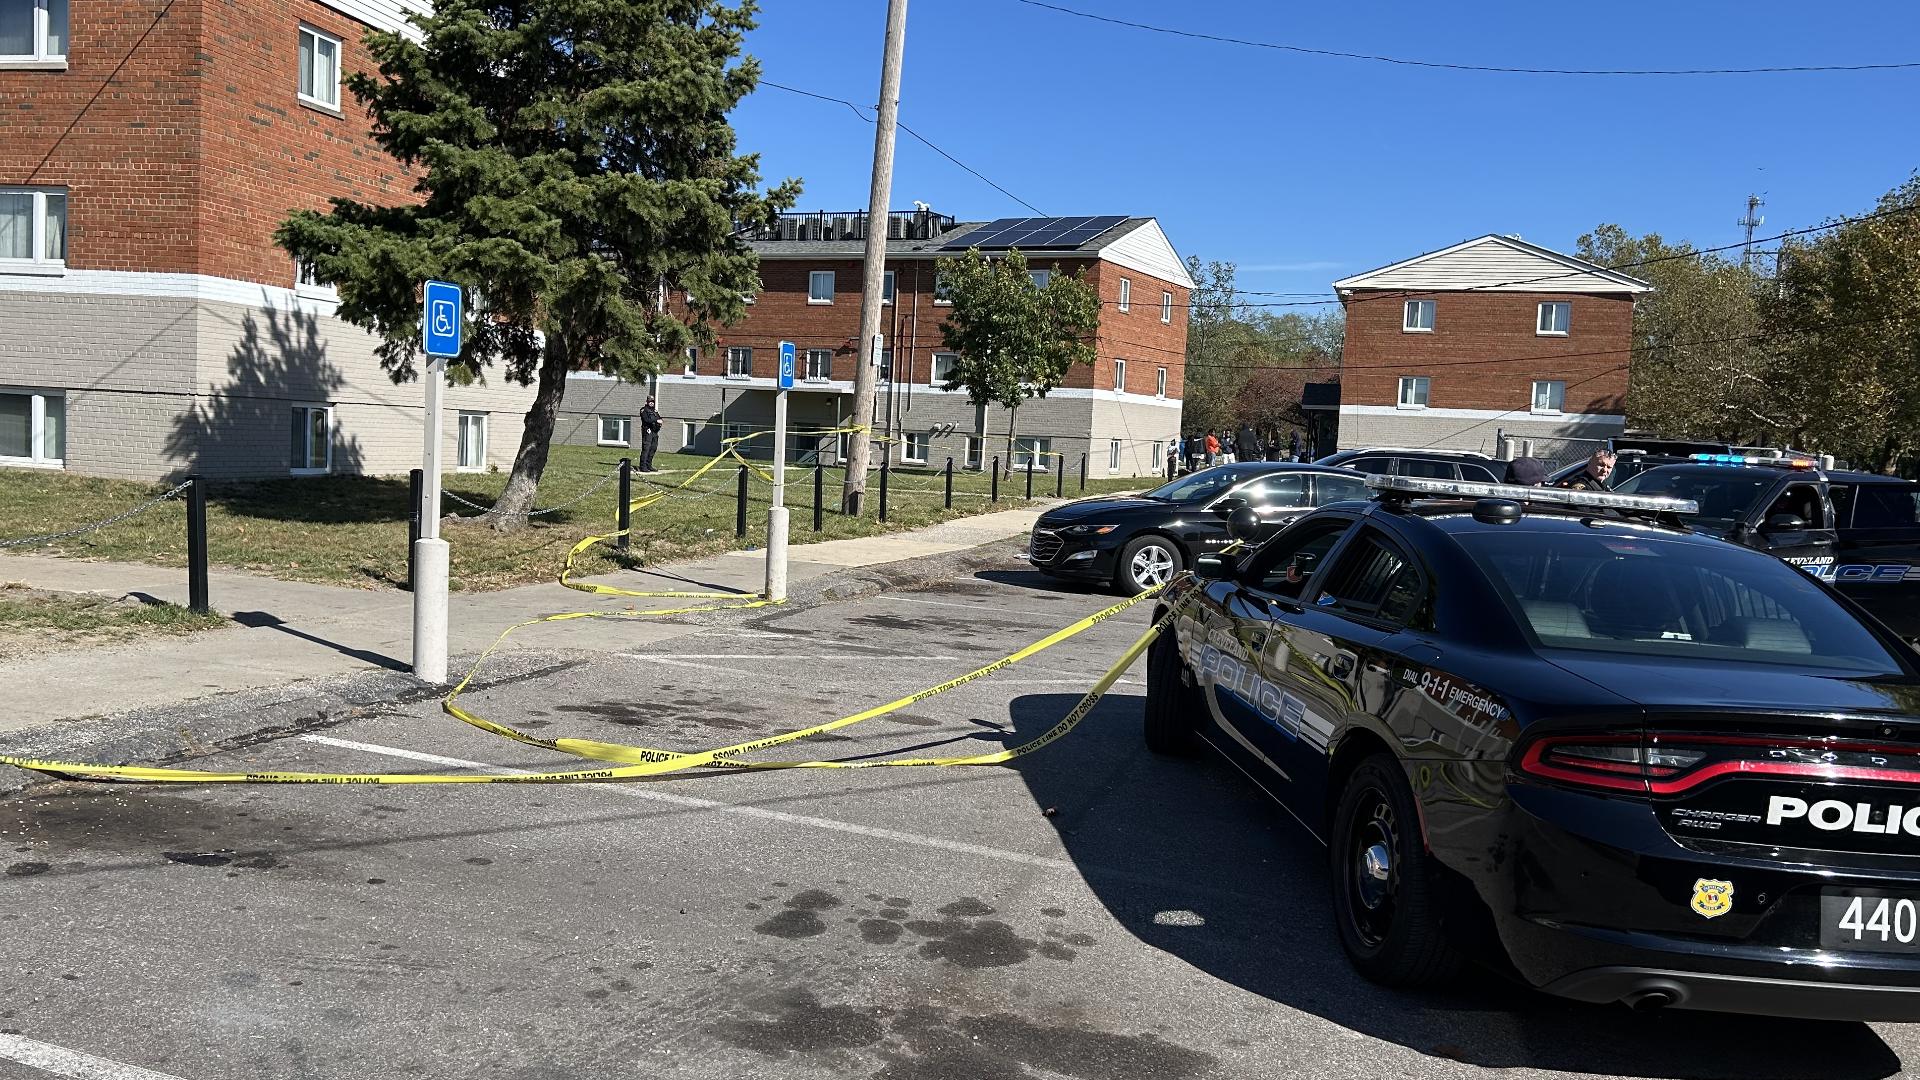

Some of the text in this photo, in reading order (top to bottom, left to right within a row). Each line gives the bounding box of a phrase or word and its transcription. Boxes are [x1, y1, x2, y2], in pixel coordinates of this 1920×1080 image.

[1782, 556, 1835, 565] EVELAND
[1799, 564, 1911, 582] OLCE
[1155, 611, 1177, 633] POLICE
[1176, 597, 1190, 613] LINE
[1190, 589, 1200, 600] DO
[1198, 643, 1306, 738] POLICE
[1402, 668, 1506, 719] DIAL 9-1-1 EMERGENCY
[1016, 692, 1099, 755] POLICE LINE DO NOT CROSS
[640, 750, 670, 763] POLICE
[1671, 808, 1762, 824] CHARGER
[1677, 818, 1722, 830] AWD
[1838, 896, 1917, 943] 440
